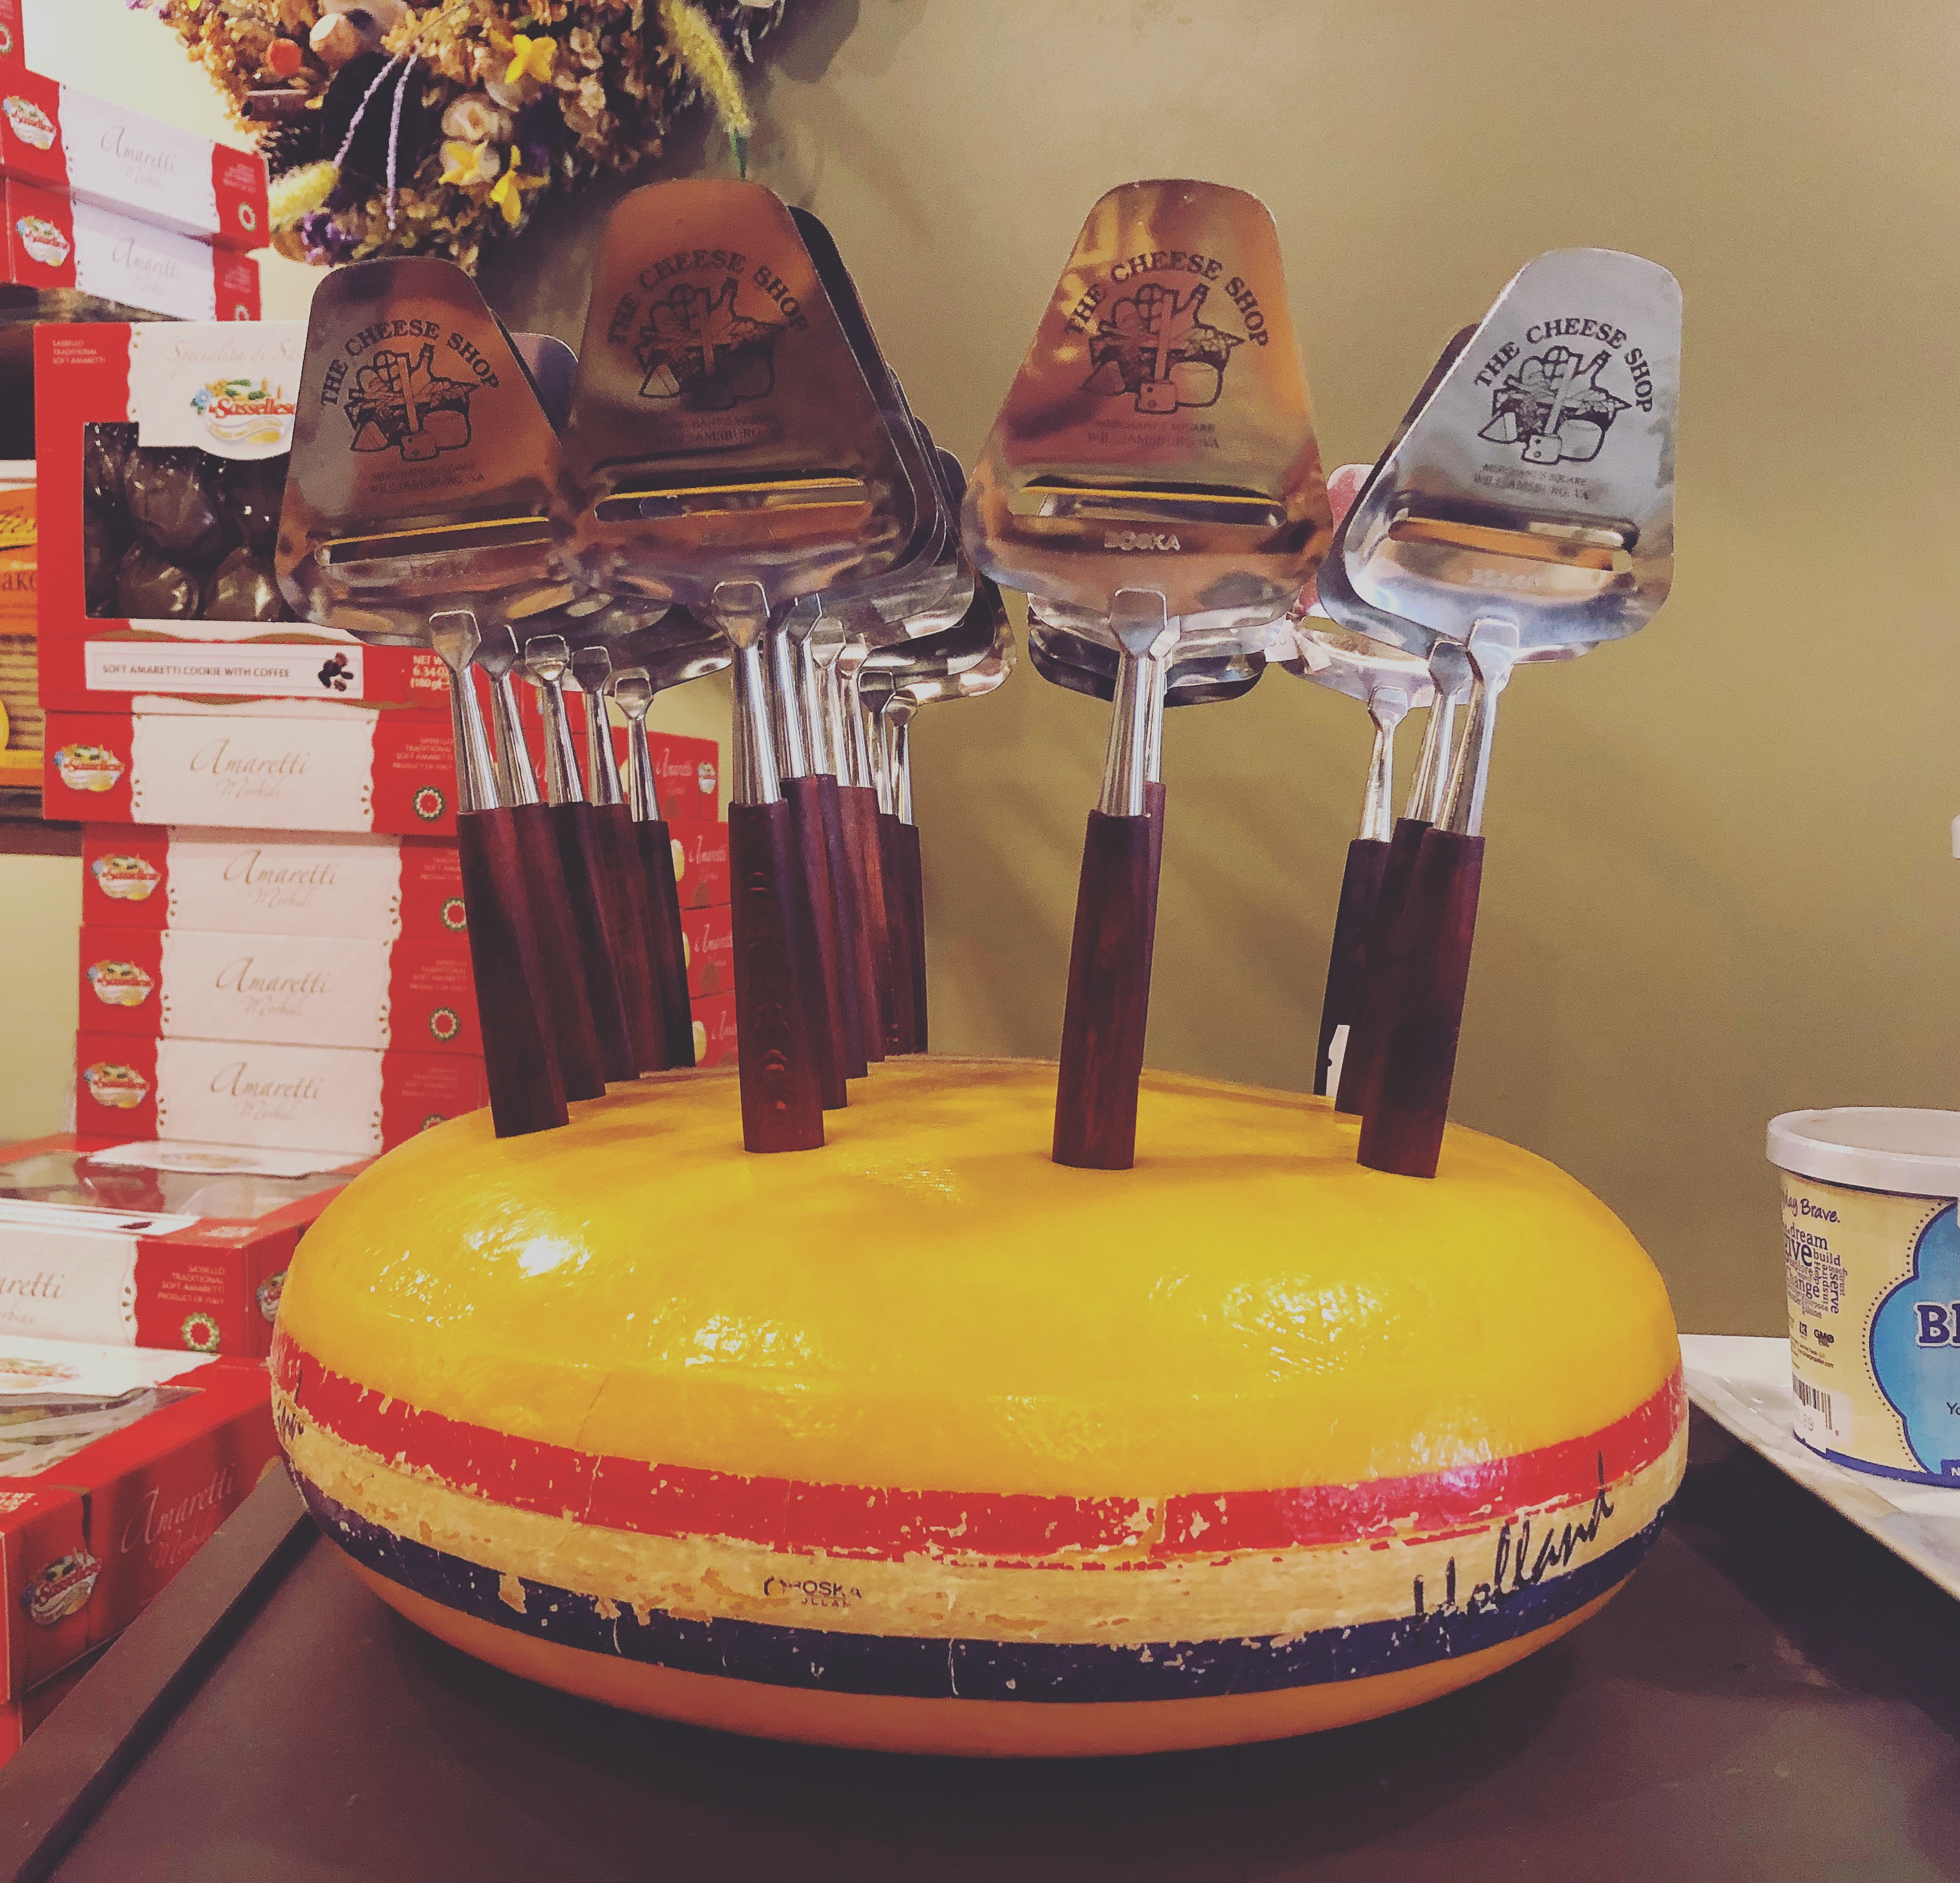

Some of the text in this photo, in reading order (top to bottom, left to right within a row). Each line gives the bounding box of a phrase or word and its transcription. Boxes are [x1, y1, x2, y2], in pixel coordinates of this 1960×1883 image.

[100, 125, 177, 172] Amaretti
[608, 249, 808, 342] THE CHEESE SHOP
[1064, 250, 1269, 347] THE CHEESE SHOP
[320, 319, 499, 405] THE CHEESE SHOP
[1474, 318, 1653, 413] THE CHEESE SHOP
[103, 664, 290, 678] SOFT AMARETTI COOKIE WITH COFFEE
[189, 738, 311, 776] Amaretti
[222, 849, 341, 885] Amaretti
[215, 956, 332, 995] Amaretti
[210, 1061, 325, 1100] Amaretti
[1800, 1198, 1841, 1223] Brave.
[1790, 1222, 1828, 1250] dream
[1814, 1248, 1840, 1267] build
[1830, 1273, 1839, 1314] serve
[121, 1462, 237, 1554] Amaretti
